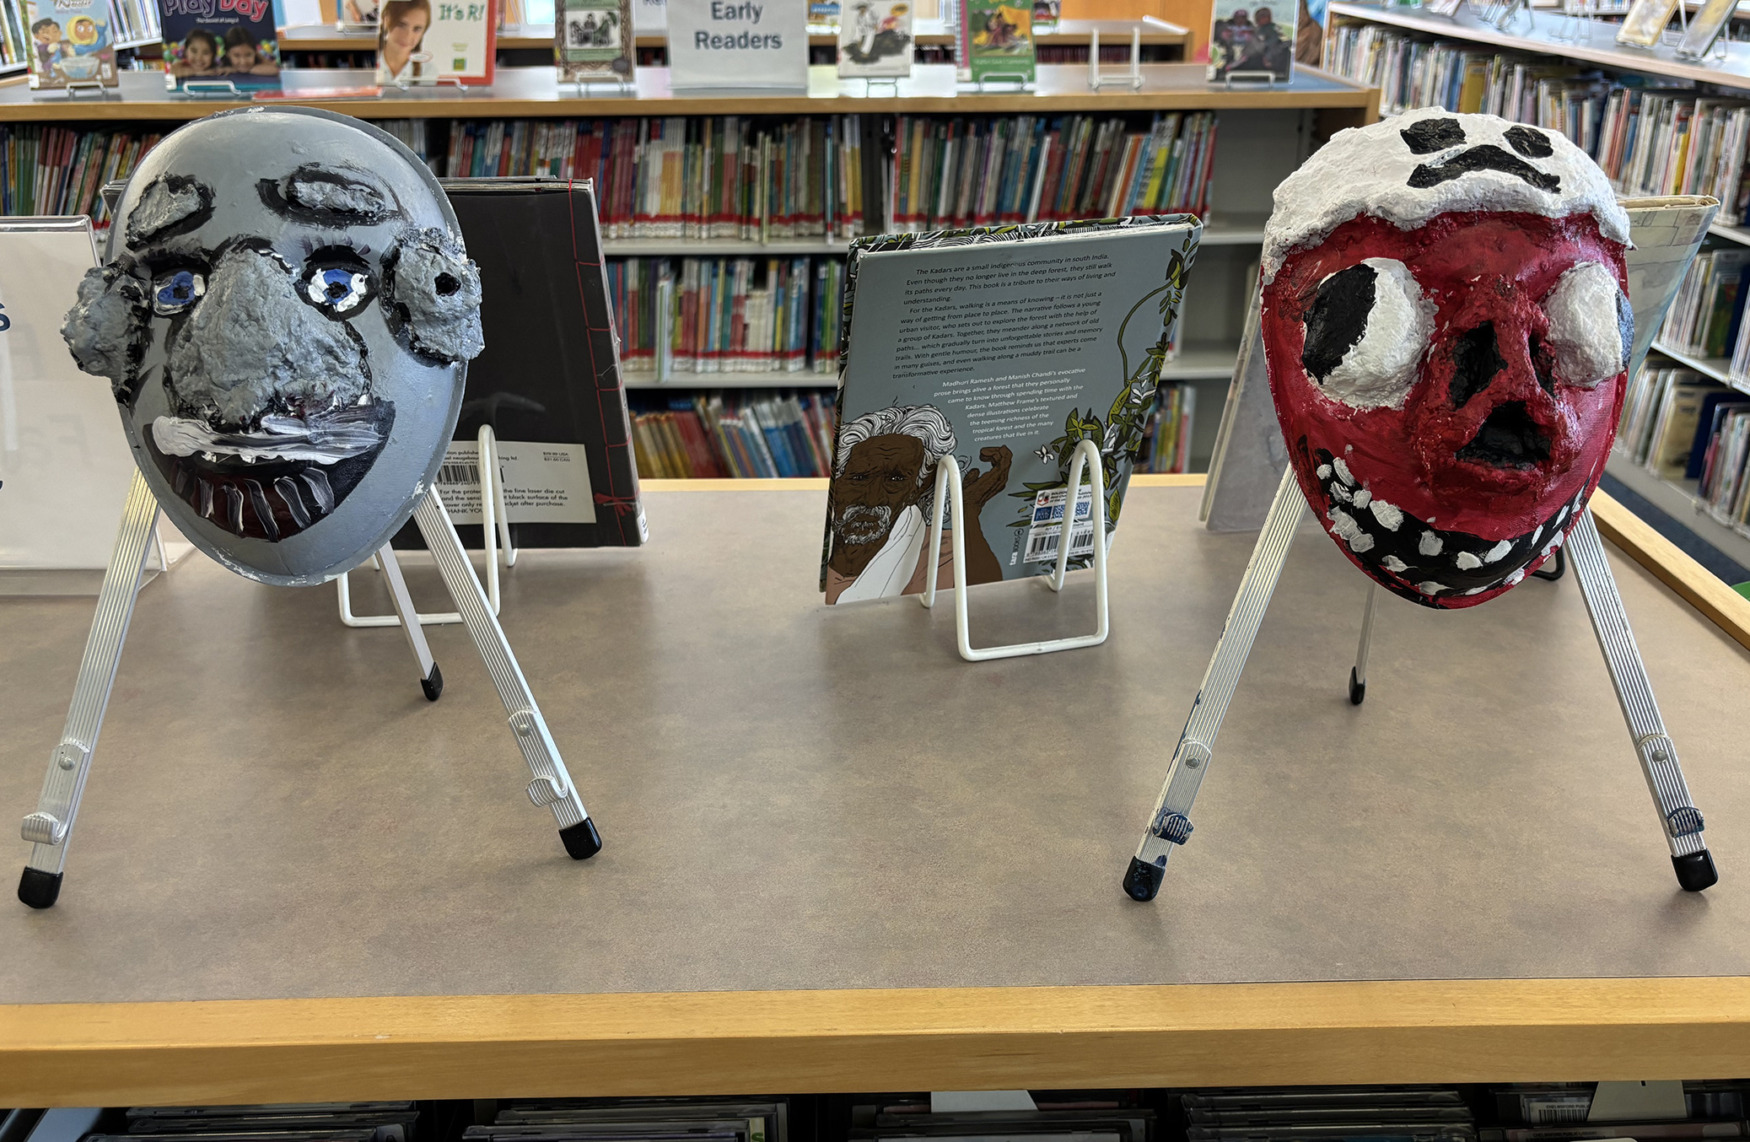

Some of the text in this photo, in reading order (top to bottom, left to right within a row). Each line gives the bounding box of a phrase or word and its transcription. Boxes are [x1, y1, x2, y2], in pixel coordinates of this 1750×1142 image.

[438, 4, 485, 21] It's R!
[711, 0, 763, 24] Early
[695, 30, 783, 50] Readers
[1027, 258, 1064, 266] community
[923, 315, 946, 323] getting
[941, 340, 971, 349] gradually
[1000, 333, 1042, 342] unforgettable
[931, 351, 951, 359] gentle
[1008, 342, 1033, 350] reminds
[892, 370, 939, 379] transformative
[1057, 368, 1086, 376] evocative
[1039, 378, 1071, 387] personally
[1016, 389, 1043, 397] spending
[1021, 405, 1049, 413] celebrate
